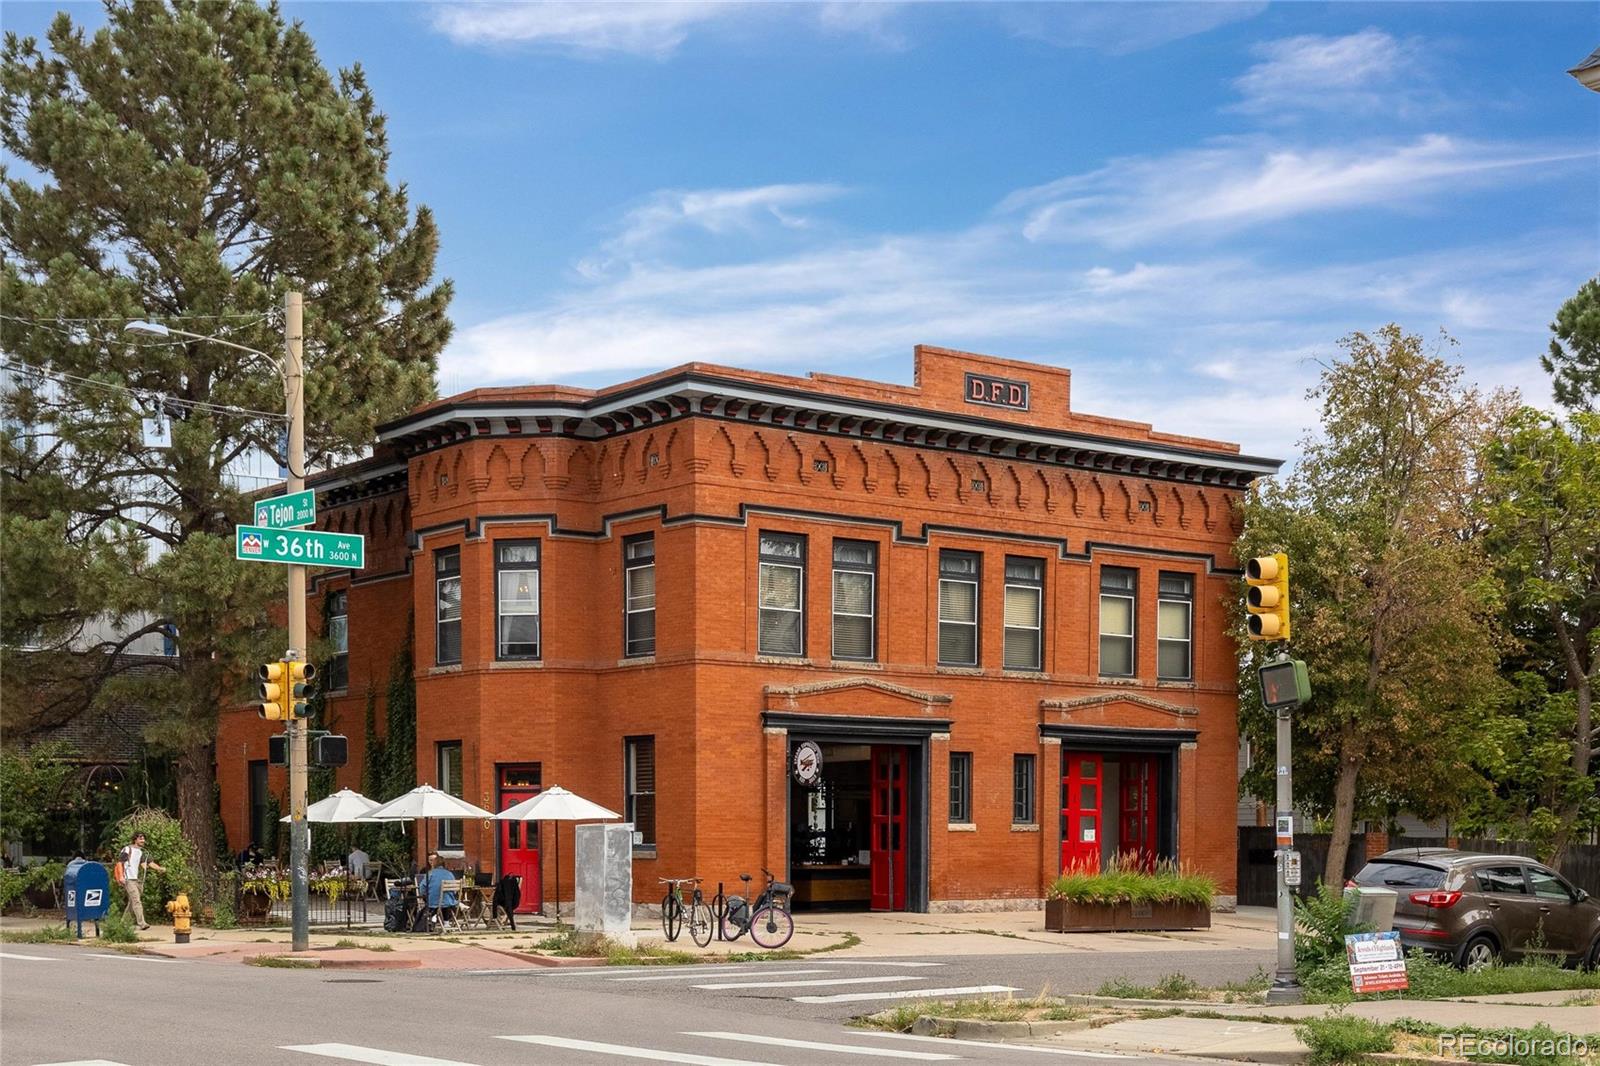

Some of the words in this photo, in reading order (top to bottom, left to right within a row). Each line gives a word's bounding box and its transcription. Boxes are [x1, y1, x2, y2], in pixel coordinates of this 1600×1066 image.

[971, 379, 1024, 405] D.F.D.
[270, 503, 294, 527] Tejon
[302, 498, 308, 507] St
[263, 539, 269, 549] W
[275, 535, 324, 559] 36th
[337, 541, 351, 550] Ave
[329, 551, 349, 561] 3600
[351, 552, 357, 562] N
